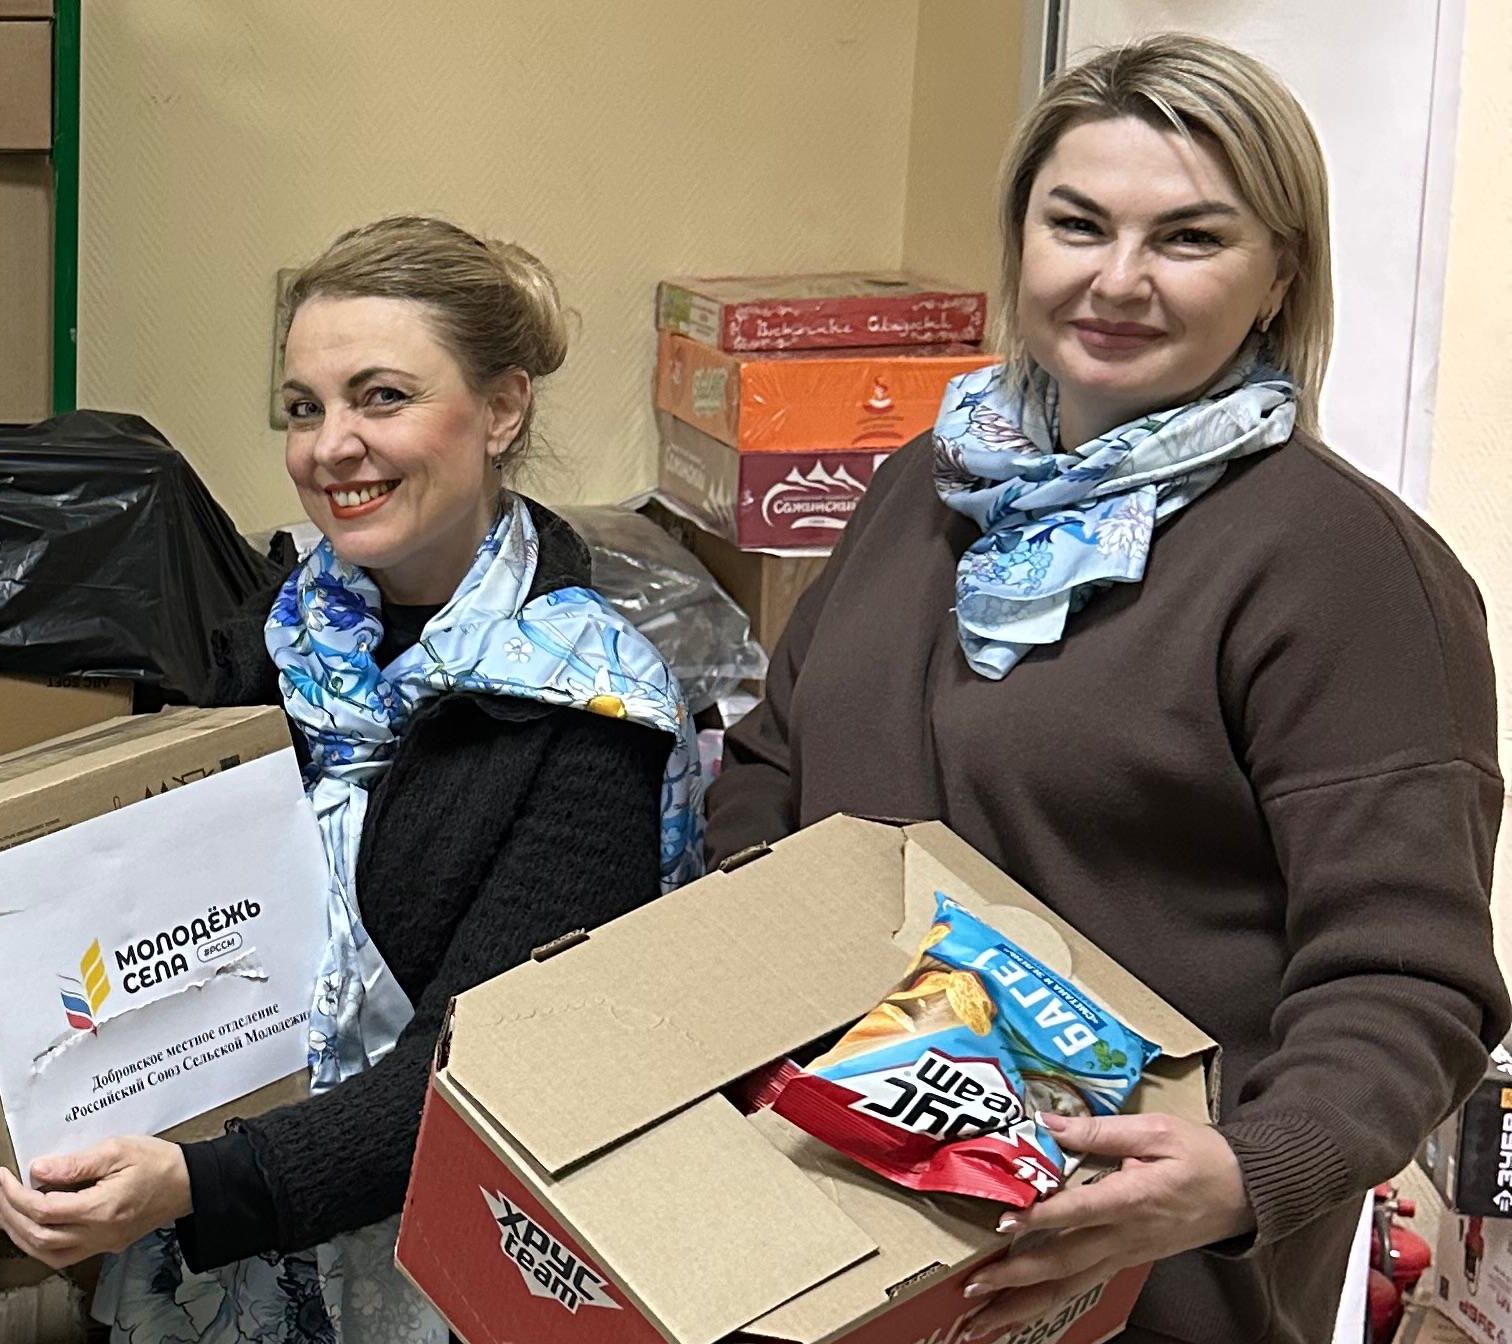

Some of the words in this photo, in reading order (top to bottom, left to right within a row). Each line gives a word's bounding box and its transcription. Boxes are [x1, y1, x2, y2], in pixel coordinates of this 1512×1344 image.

[114, 899, 262, 971] МОЛОДЁЖЬ
[122, 953, 189, 994] СЕЛА
[961, 947, 1099, 1057] БАГЕТ
[92, 1049, 164, 1093] Добровское
[165, 1028, 216, 1059] местное
[218, 1002, 280, 1037] отделение
[147, 1065, 181, 1087] Союз
[182, 1036, 244, 1072] Сельской
[504, 1232, 579, 1310] team
